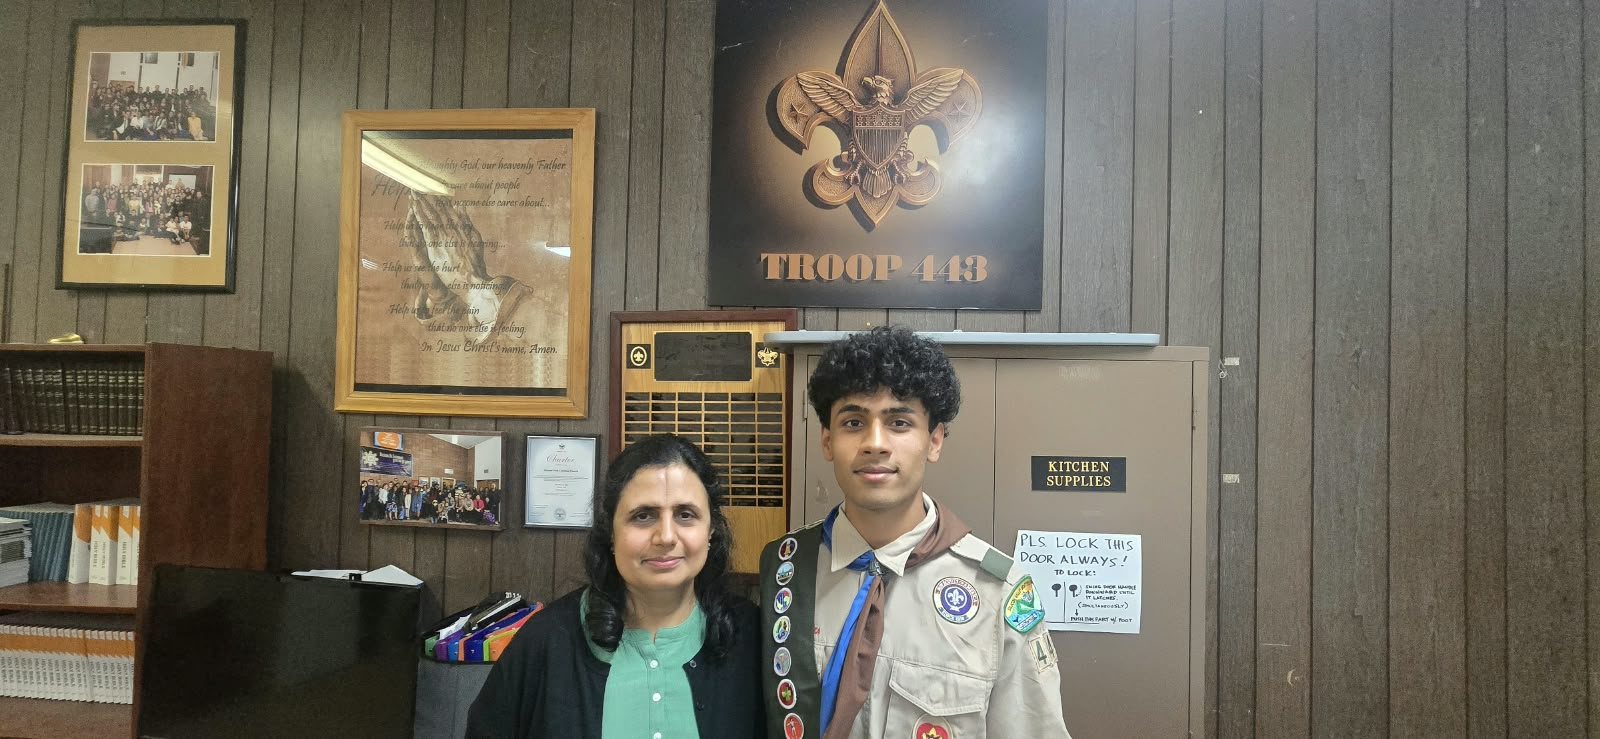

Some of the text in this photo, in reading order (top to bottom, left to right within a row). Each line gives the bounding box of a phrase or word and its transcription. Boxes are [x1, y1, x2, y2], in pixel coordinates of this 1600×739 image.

[421, 158, 458, 174] mighty
[498, 158, 534, 174] heavenly
[536, 159, 566, 171] Father
[469, 177, 493, 190] about
[494, 178, 520, 195] people
[482, 197, 496, 208] else
[518, 196, 550, 208] about...
[444, 236, 458, 248] else
[383, 261, 402, 277] Help
[442, 260, 461, 272] hurt
[760, 252, 988, 282] TROOP 443
[447, 279, 460, 290] else
[462, 280, 469, 290] is
[390, 304, 410, 320] Help
[428, 322, 446, 333] that
[474, 321, 489, 333] else
[421, 338, 558, 356] In Jesus Christ's name, Amen.
[1048, 461, 1110, 472] KITCHEN
[1046, 476, 1111, 487] SUPPLIES
[1056, 536, 1098, 550] LOCK
[1105, 538, 1134, 552] THIS
[1020, 552, 1055, 564] DOOR
